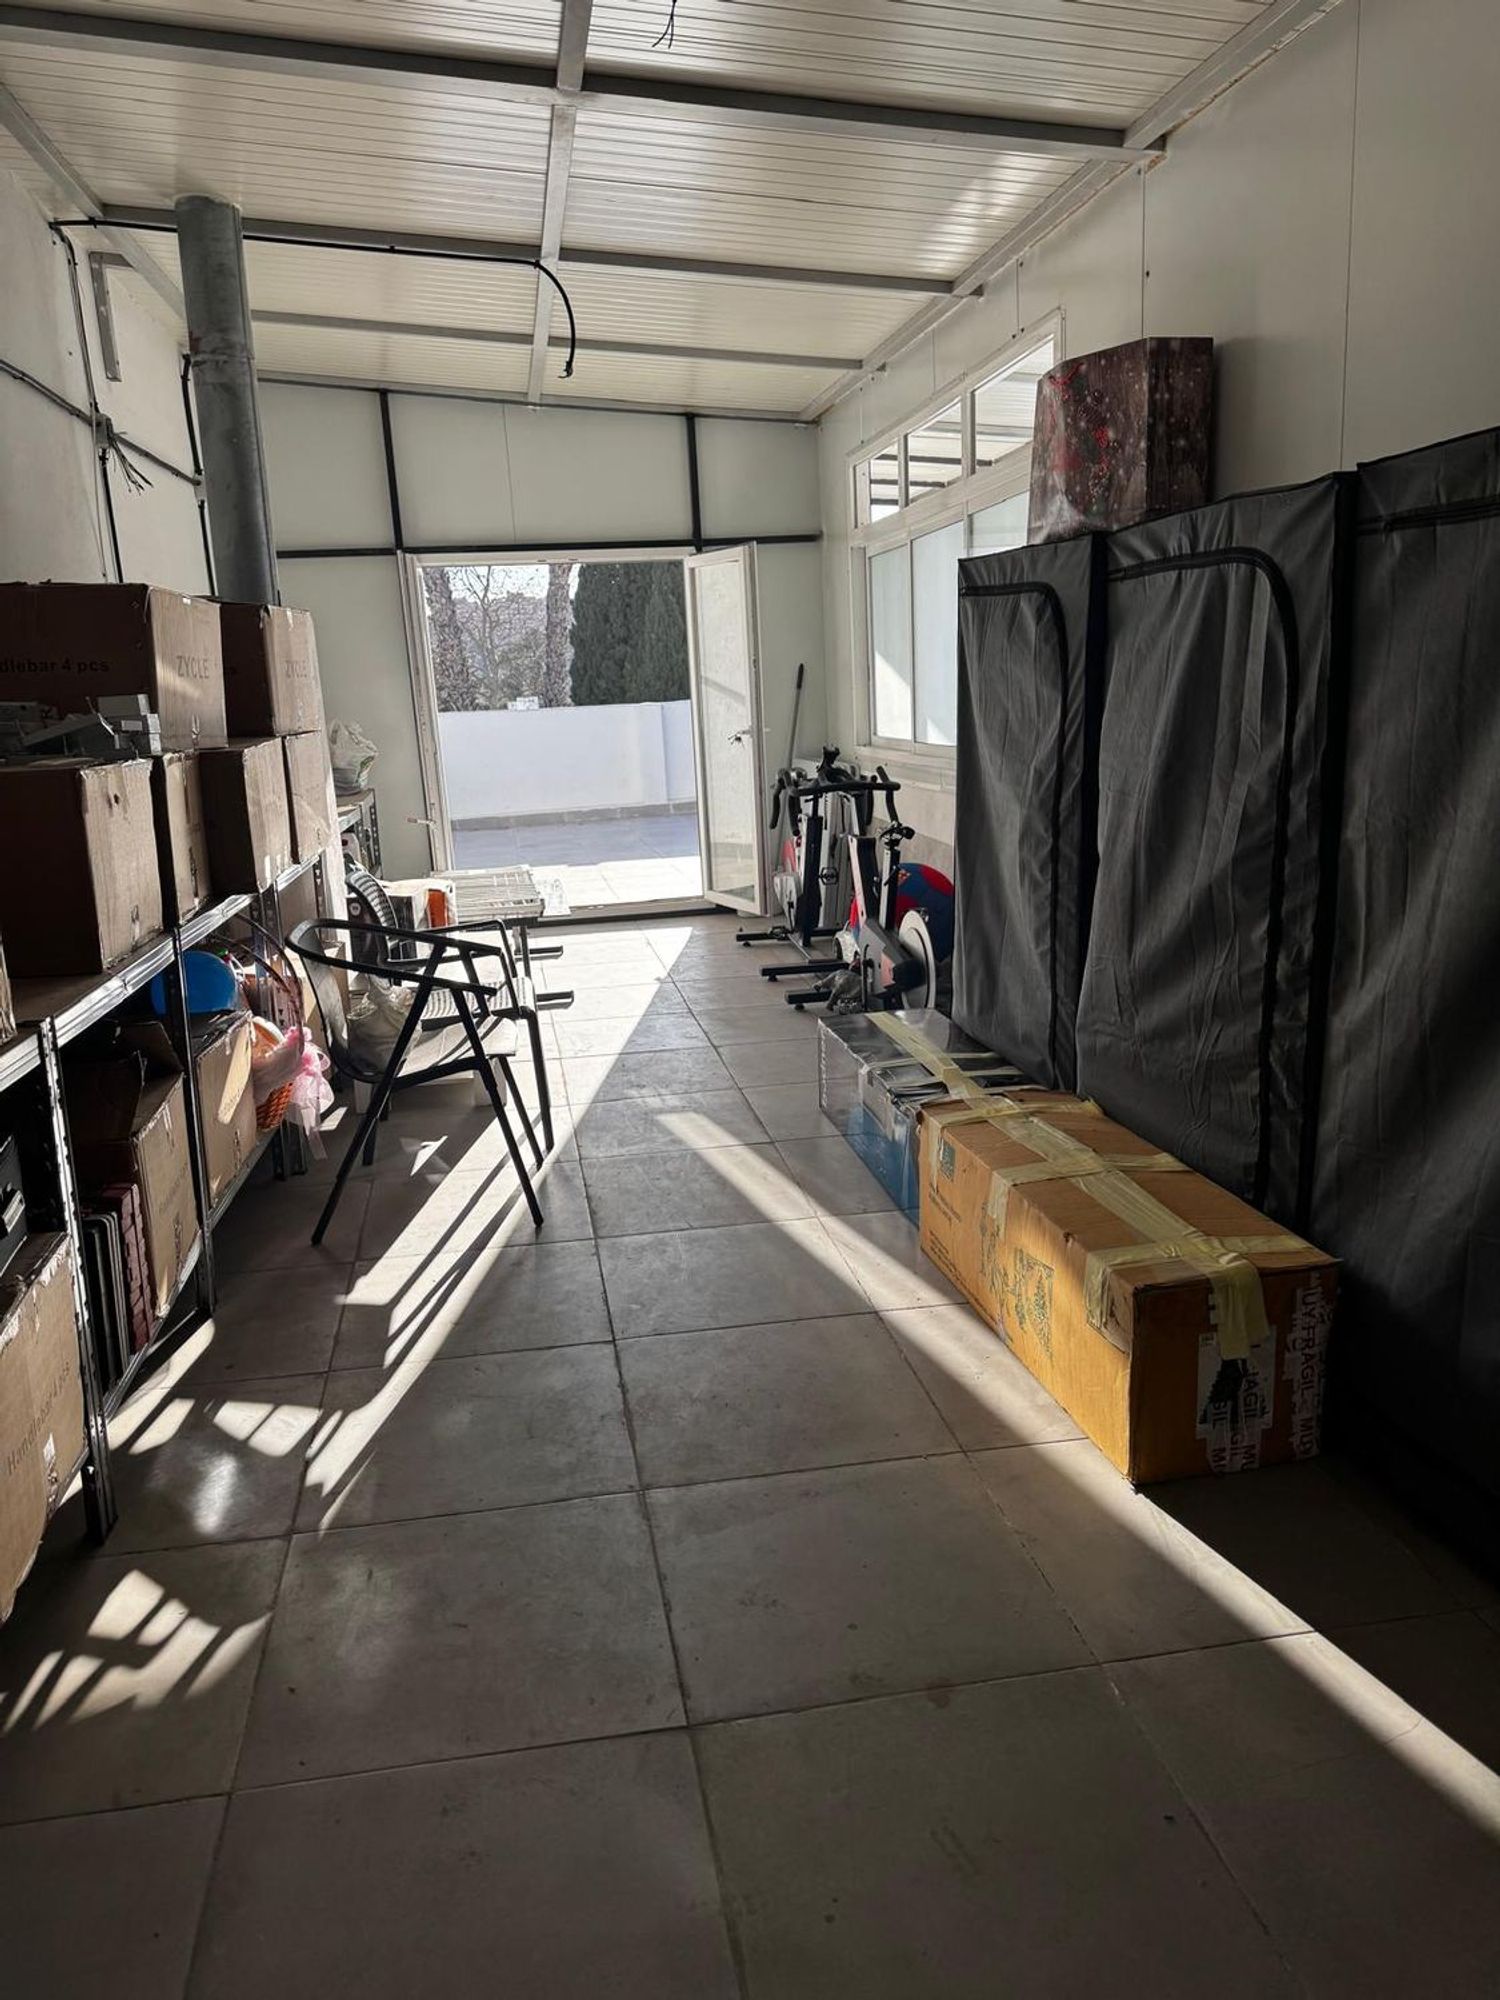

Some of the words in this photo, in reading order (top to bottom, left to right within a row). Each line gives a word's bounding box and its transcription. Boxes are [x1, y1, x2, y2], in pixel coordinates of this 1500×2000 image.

[61, 656, 72, 671] 4
[77, 659, 110, 675] pcs
[176, 655, 210, 680] ZYCLE
[1300, 1326, 1316, 1397] FRAGIL
